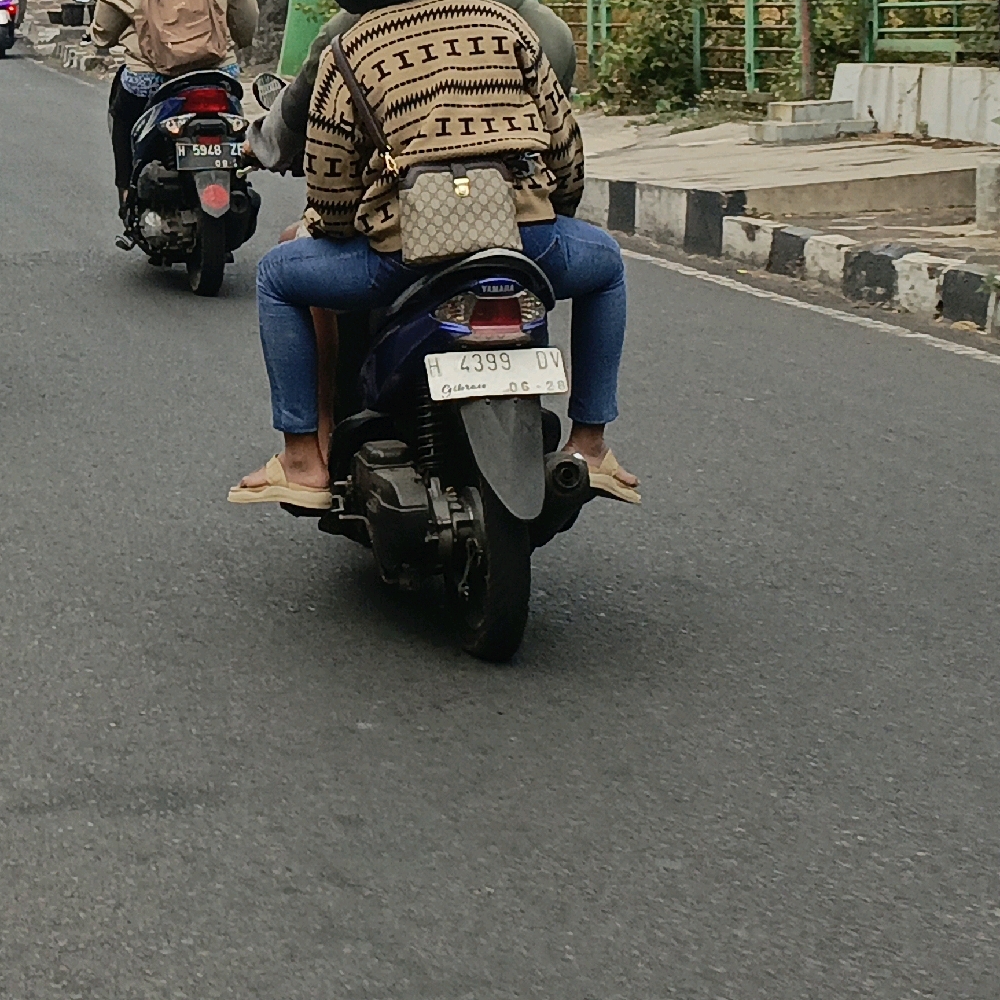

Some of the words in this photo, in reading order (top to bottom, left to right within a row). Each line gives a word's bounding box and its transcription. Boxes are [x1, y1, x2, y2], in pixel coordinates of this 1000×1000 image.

[178, 145, 186, 157] H
[192, 144, 222, 156] 5948
[481, 284, 515, 293] YAMAHA
[427, 357, 443, 378] H
[460, 352, 512, 373] 4399
[535, 350, 560, 370] DV
